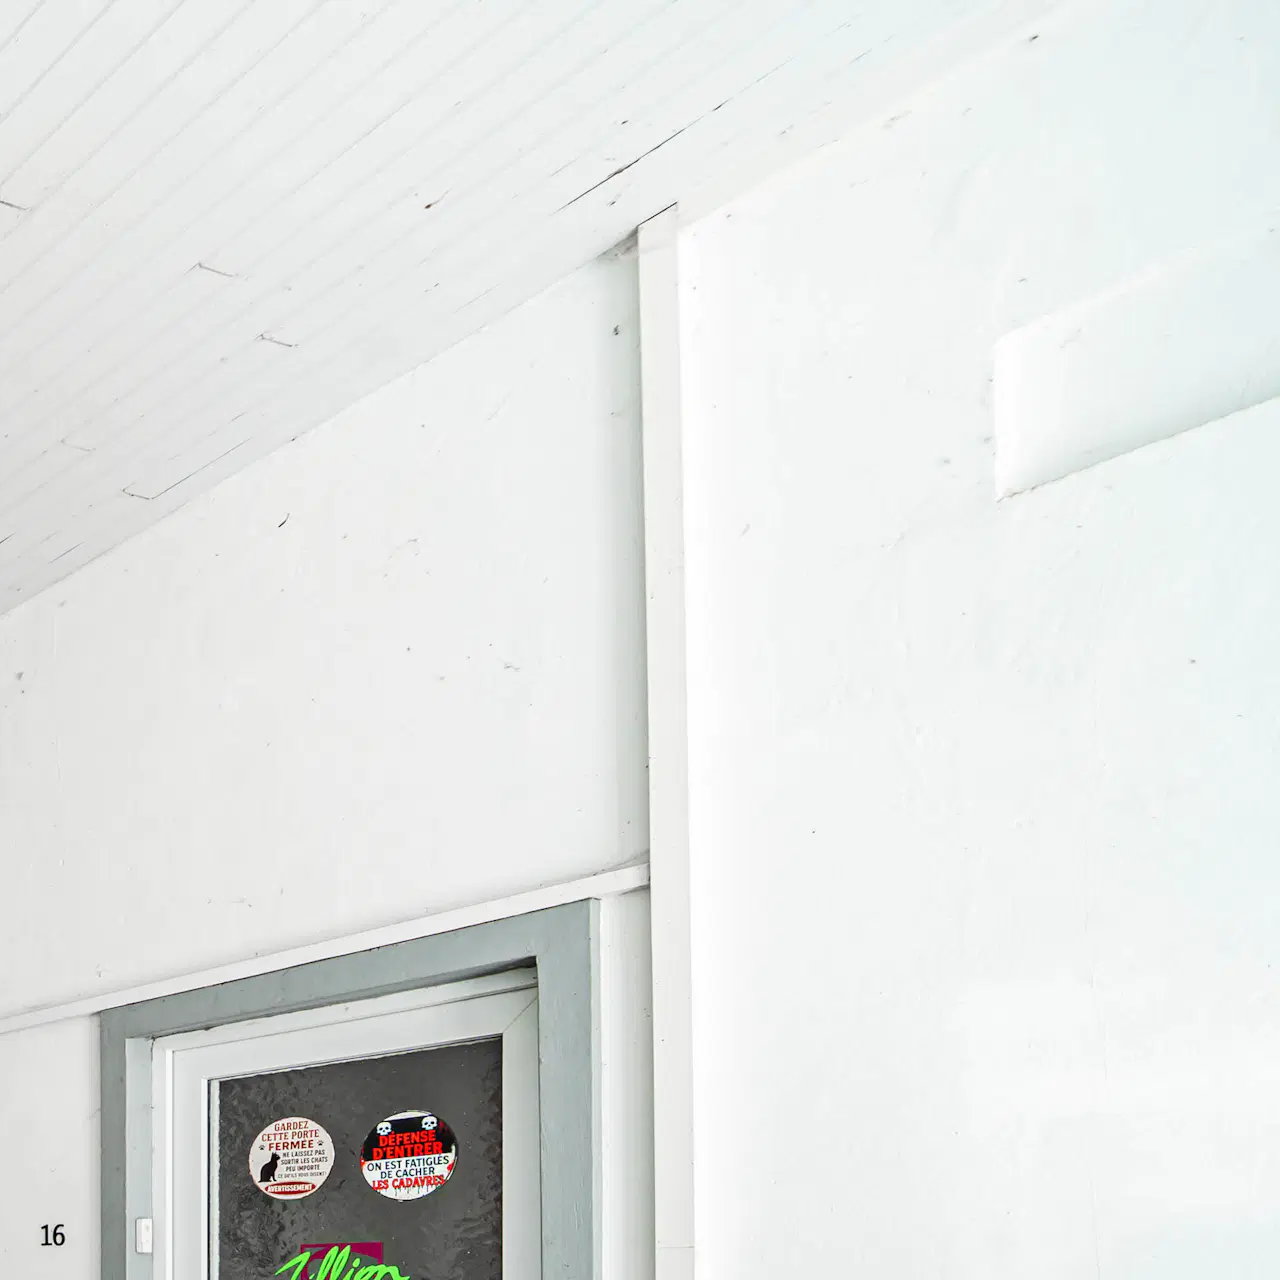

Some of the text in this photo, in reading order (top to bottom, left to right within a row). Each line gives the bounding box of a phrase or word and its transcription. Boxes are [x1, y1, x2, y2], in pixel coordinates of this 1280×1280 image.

[274, 1120, 309, 1132] GARDEZ
[261, 1129, 320, 1142] CETTE PORTE
[378, 1129, 437, 1147] DÉFENSE
[372, 1141, 443, 1160] D'ENTRER
[297, 1164, 320, 1172] IMPORTE
[367, 1162, 382, 1172] ON
[385, 1160, 402, 1170] EST
[380, 1167, 435, 1179] DE CACHER
[267, 1184, 312, 1192] AVERTISSEMENT
[372, 1175, 446, 1190] LES CADAVRES
[40, 1224, 65, 1246] 16
